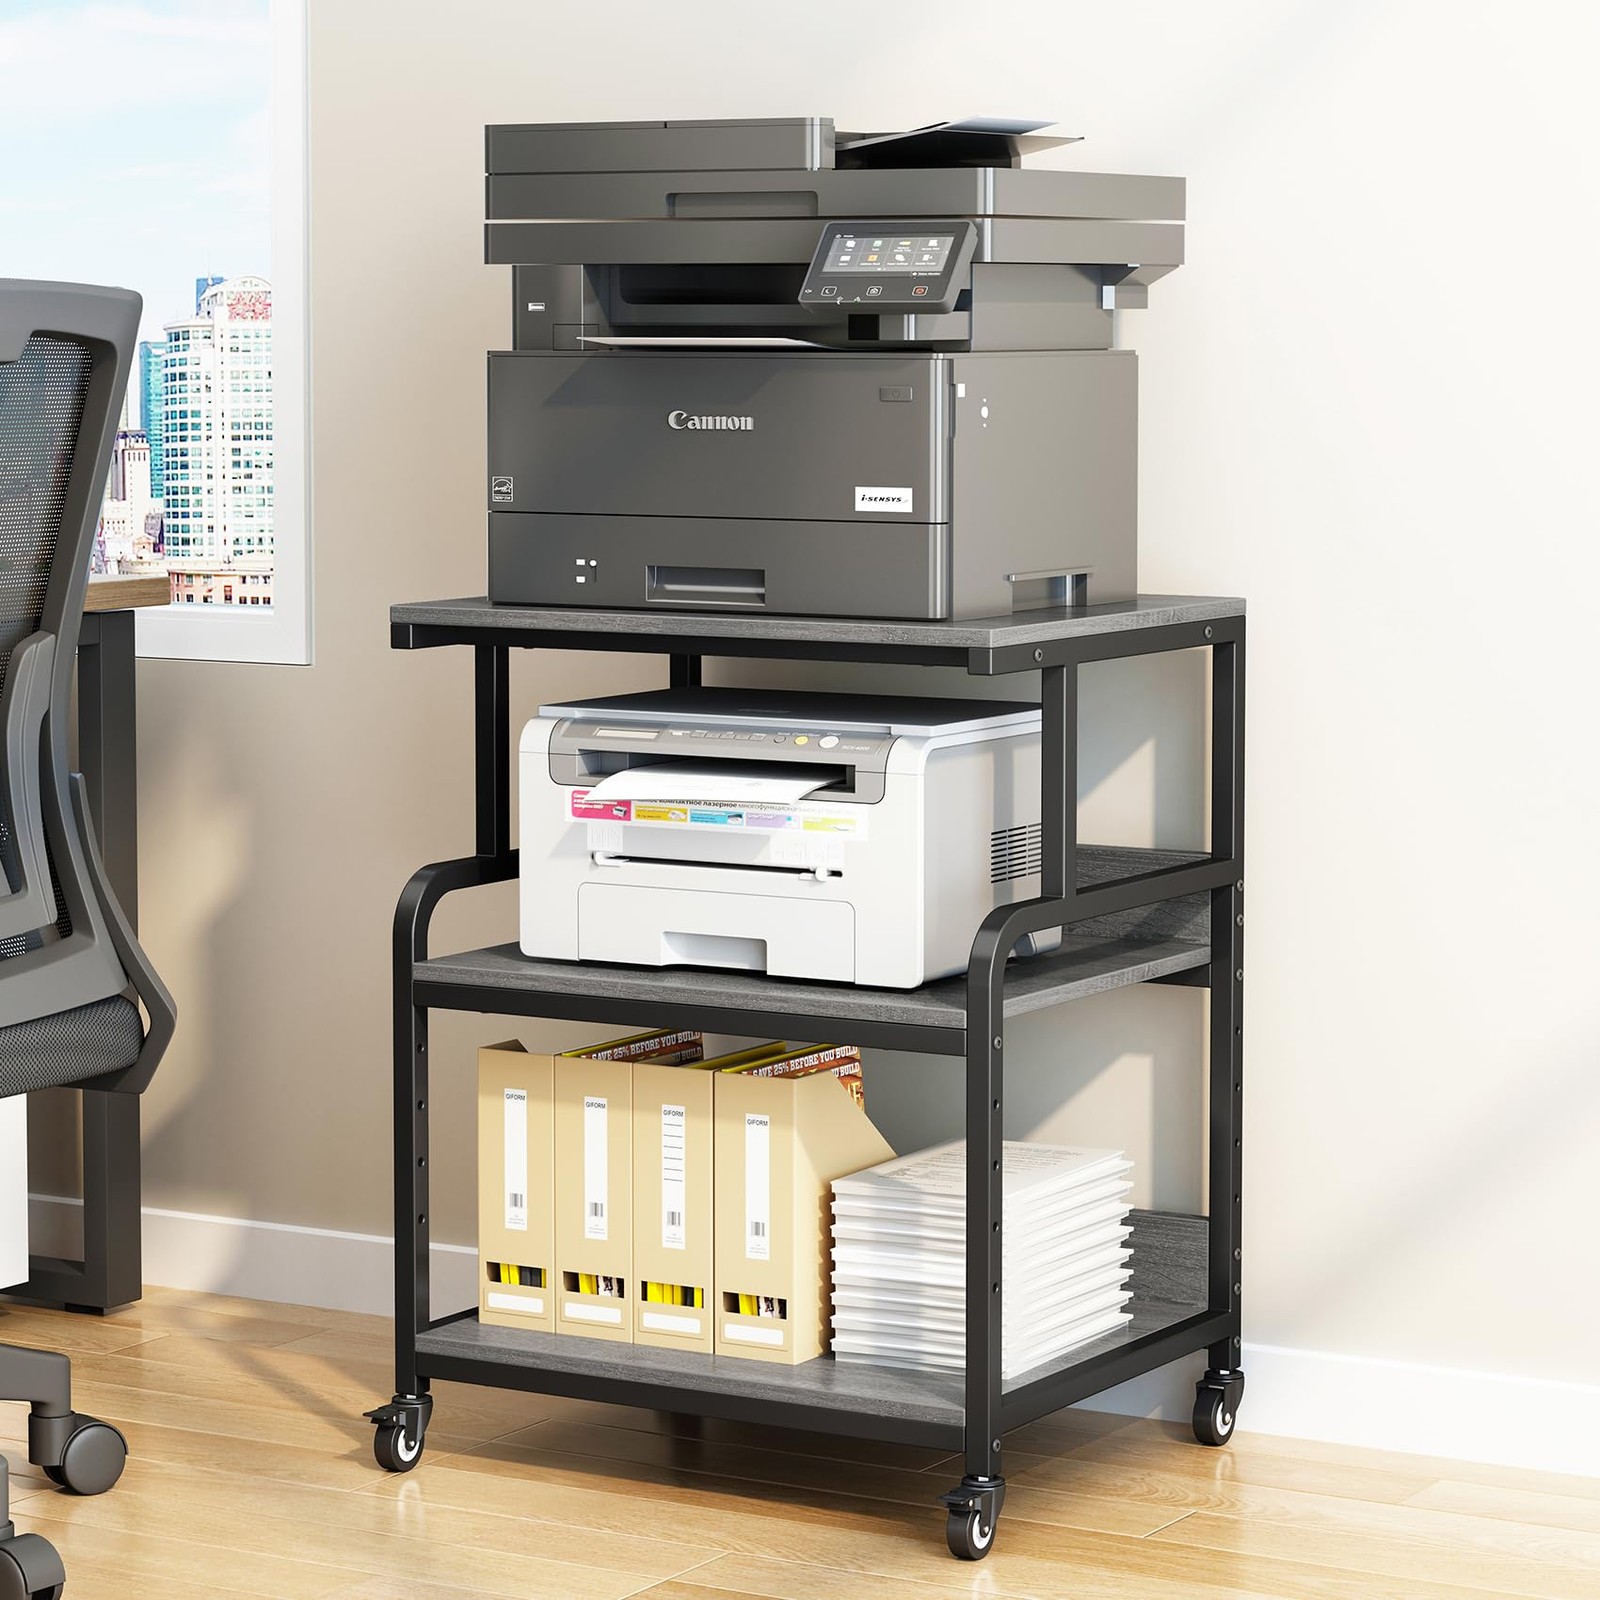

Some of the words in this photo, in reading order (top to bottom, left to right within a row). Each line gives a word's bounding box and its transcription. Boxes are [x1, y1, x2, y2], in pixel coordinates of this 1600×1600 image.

[668, 410, 754, 431] Cannon
[613, 1046, 630, 1058] 25%
[630, 1039, 660, 1055] BEFORE
[660, 1033, 678, 1047] YOU
[677, 1031, 701, 1044] BUILD
[681, 1046, 702, 1060] BUILD
[753, 1065, 773, 1078] SAVE
[773, 1062, 789, 1075] 25%
[790, 1053, 819, 1071] BEFORE
[819, 1049, 835, 1063] YOU
[835, 1045, 858, 1059] BUILD
[840, 1061, 860, 1076] BUILD
[505, 1093, 526, 1101] GIFORM
[585, 1101, 606, 1109] GIFORM
[663, 1109, 684, 1117] GIFORM
[747, 1118, 768, 1127] GIFORM
